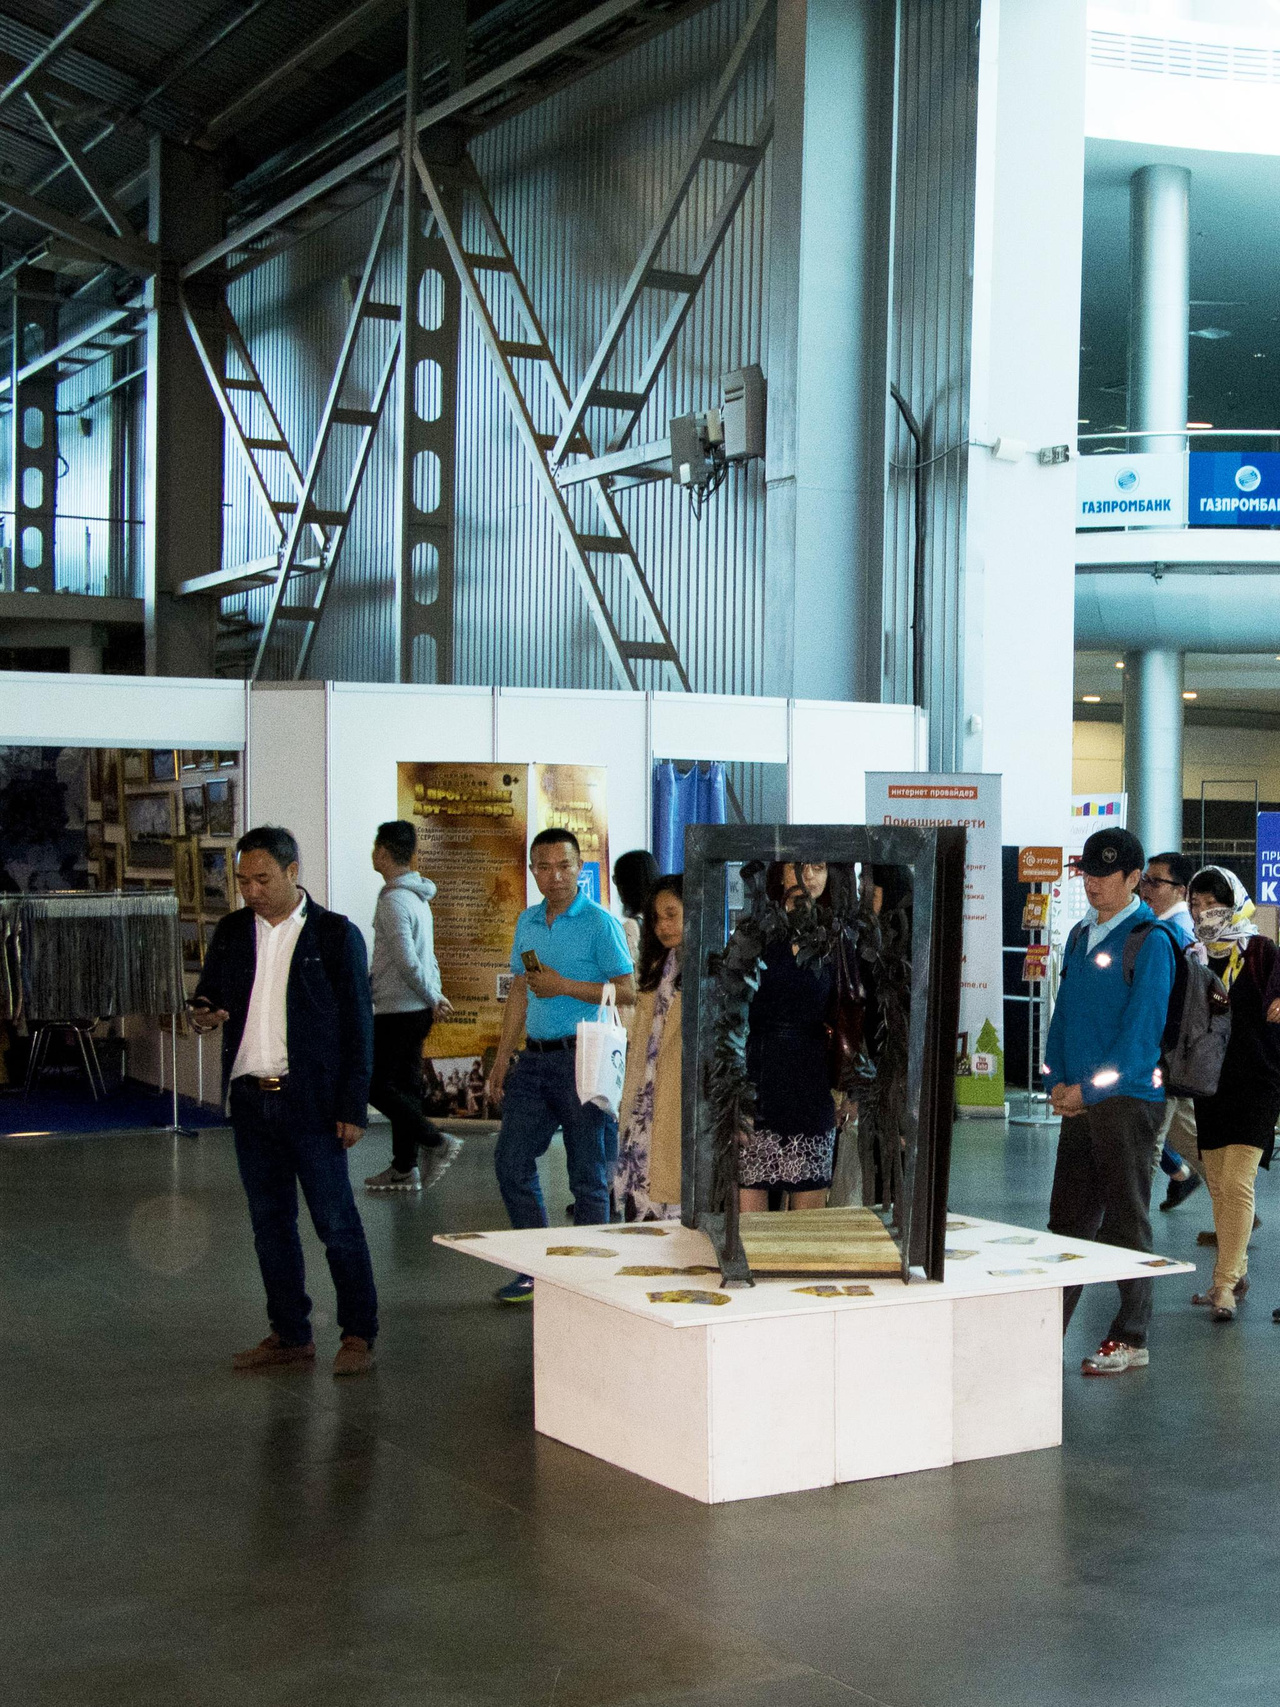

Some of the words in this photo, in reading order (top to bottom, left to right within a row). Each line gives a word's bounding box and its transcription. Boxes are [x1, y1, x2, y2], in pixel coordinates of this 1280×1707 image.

[1082, 499, 1171, 514] ГАЗПРОМБАНК
[891, 788, 928, 797] интернет
[930, 788, 975, 798] провайдер
[957, 819, 986, 828] сети
